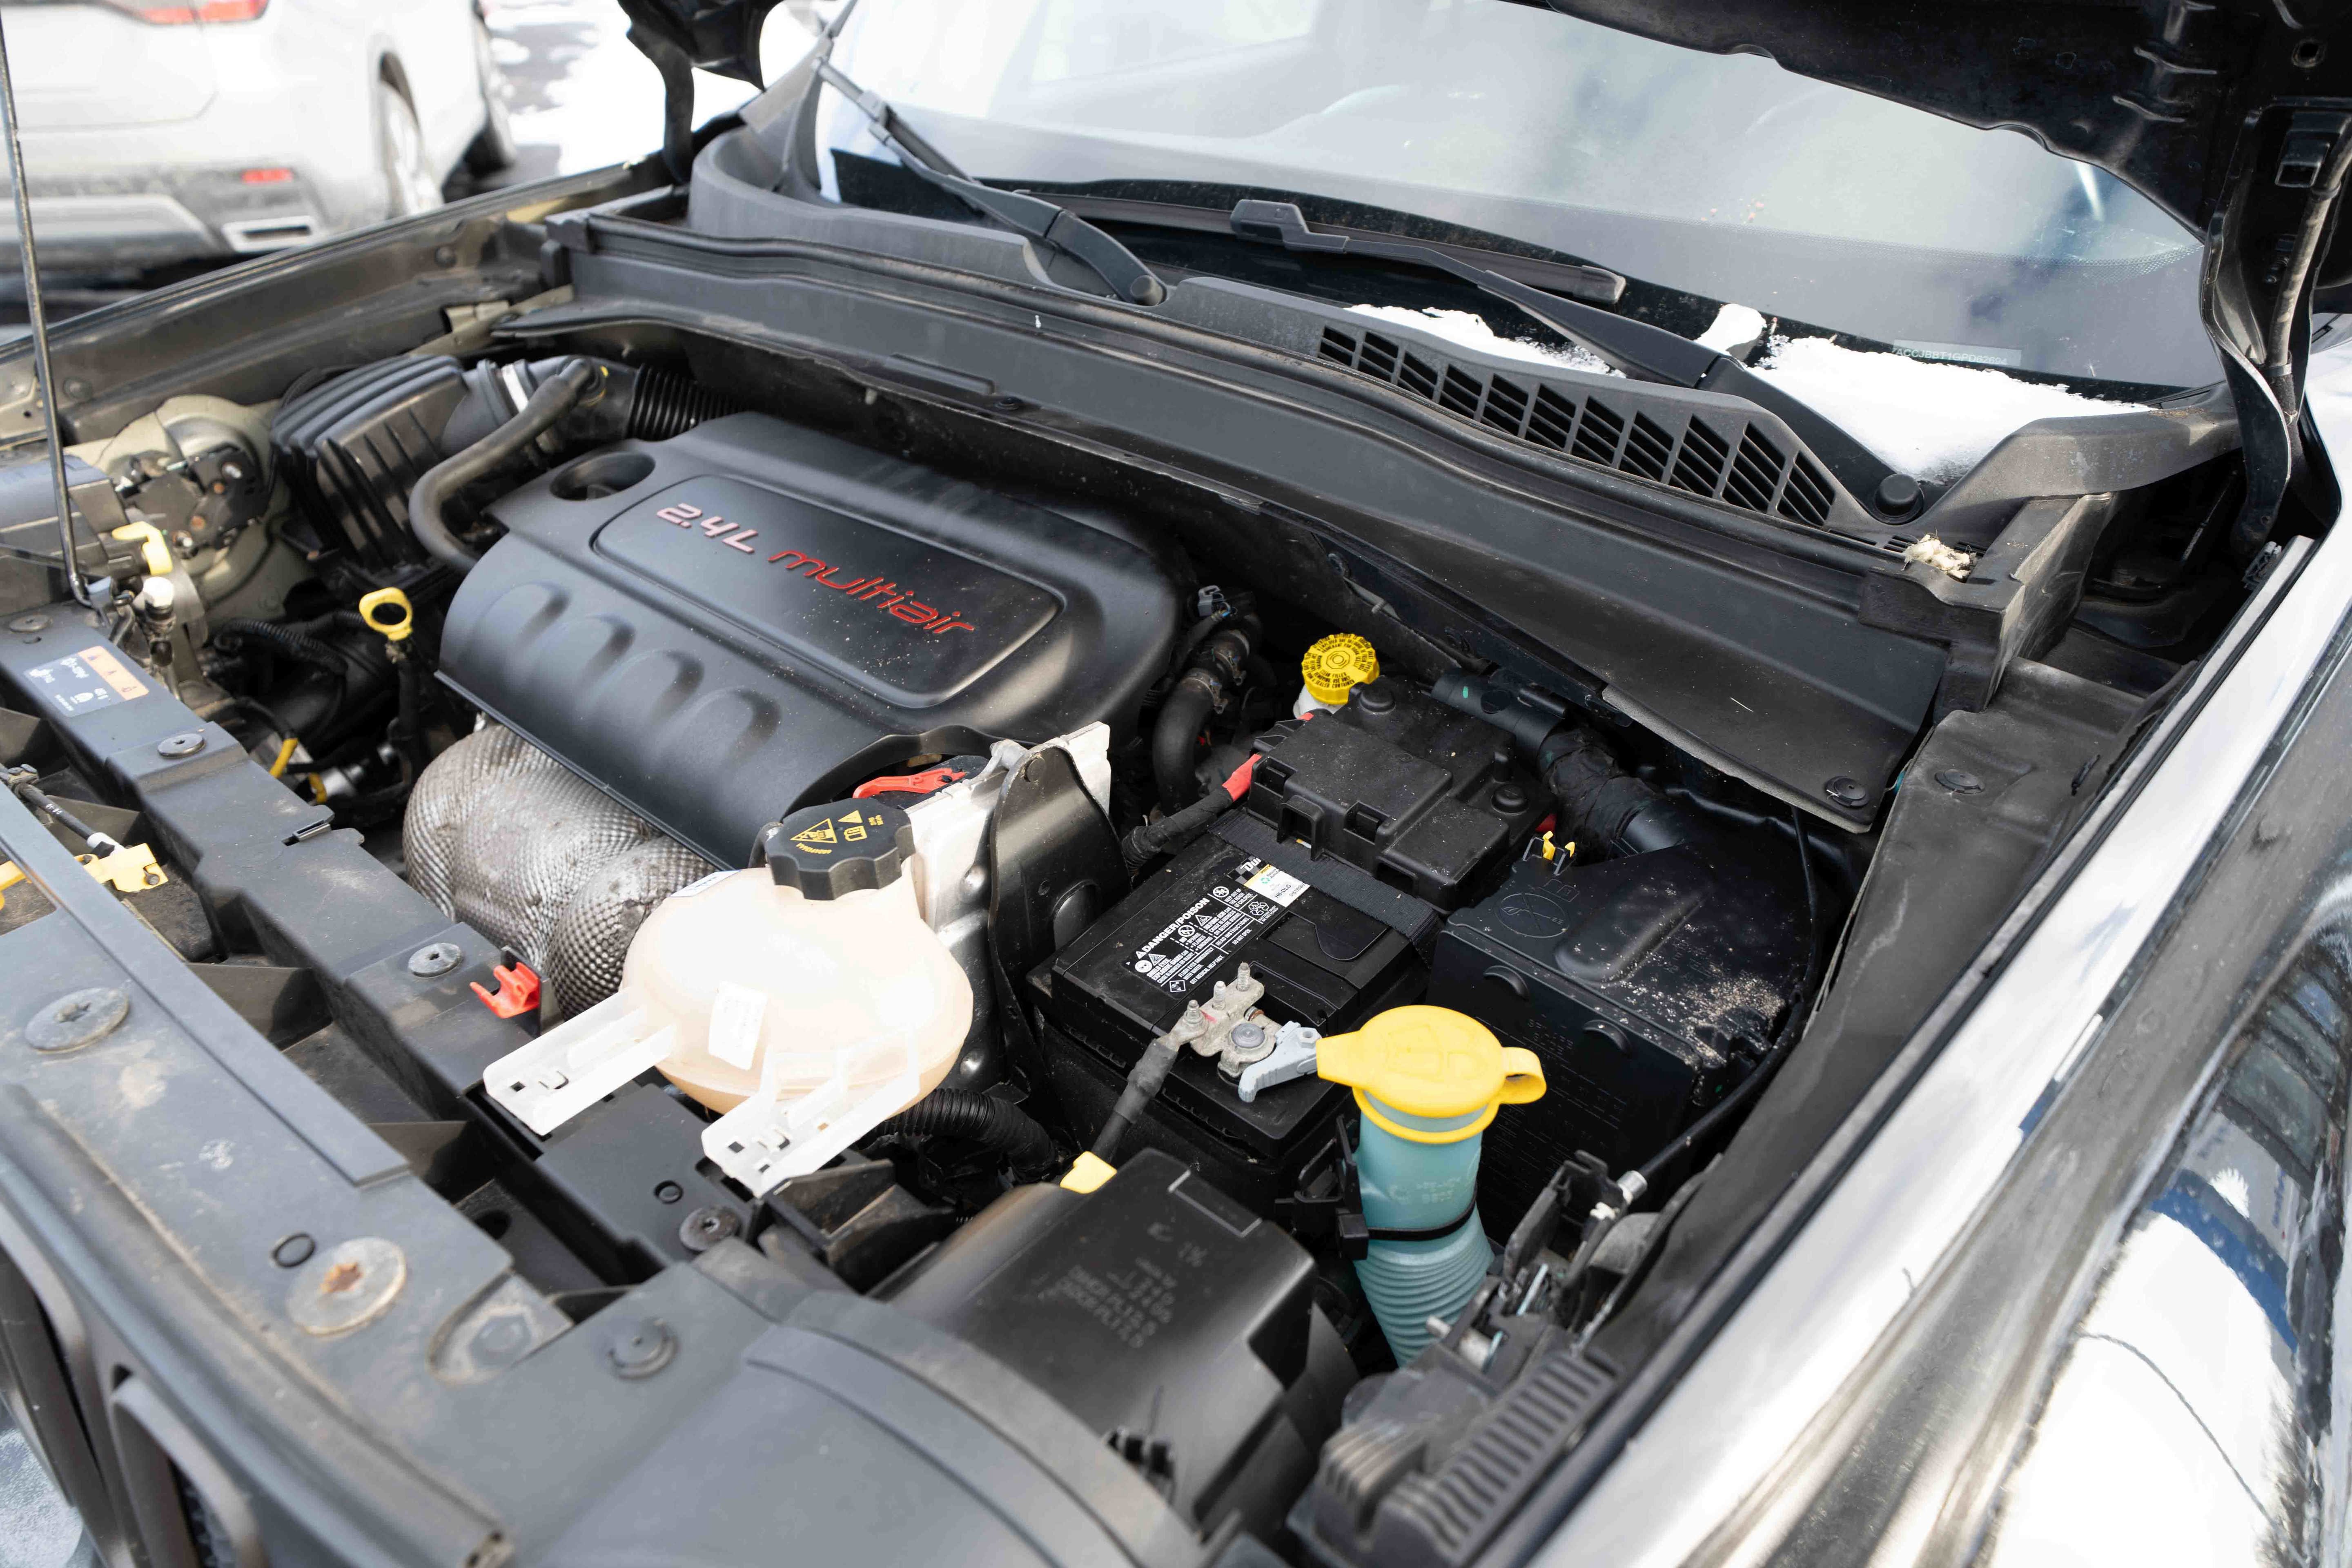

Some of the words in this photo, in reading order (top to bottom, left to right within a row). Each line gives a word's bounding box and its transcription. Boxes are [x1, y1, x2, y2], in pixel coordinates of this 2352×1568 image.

[656, 502, 759, 554] 2.4L
[767, 549, 975, 634] multiair
[1332, 679, 1355, 688] CONTAINER
[1141, 896, 1210, 953] DANGER/POISON
[1215, 935, 1228, 946] READ
